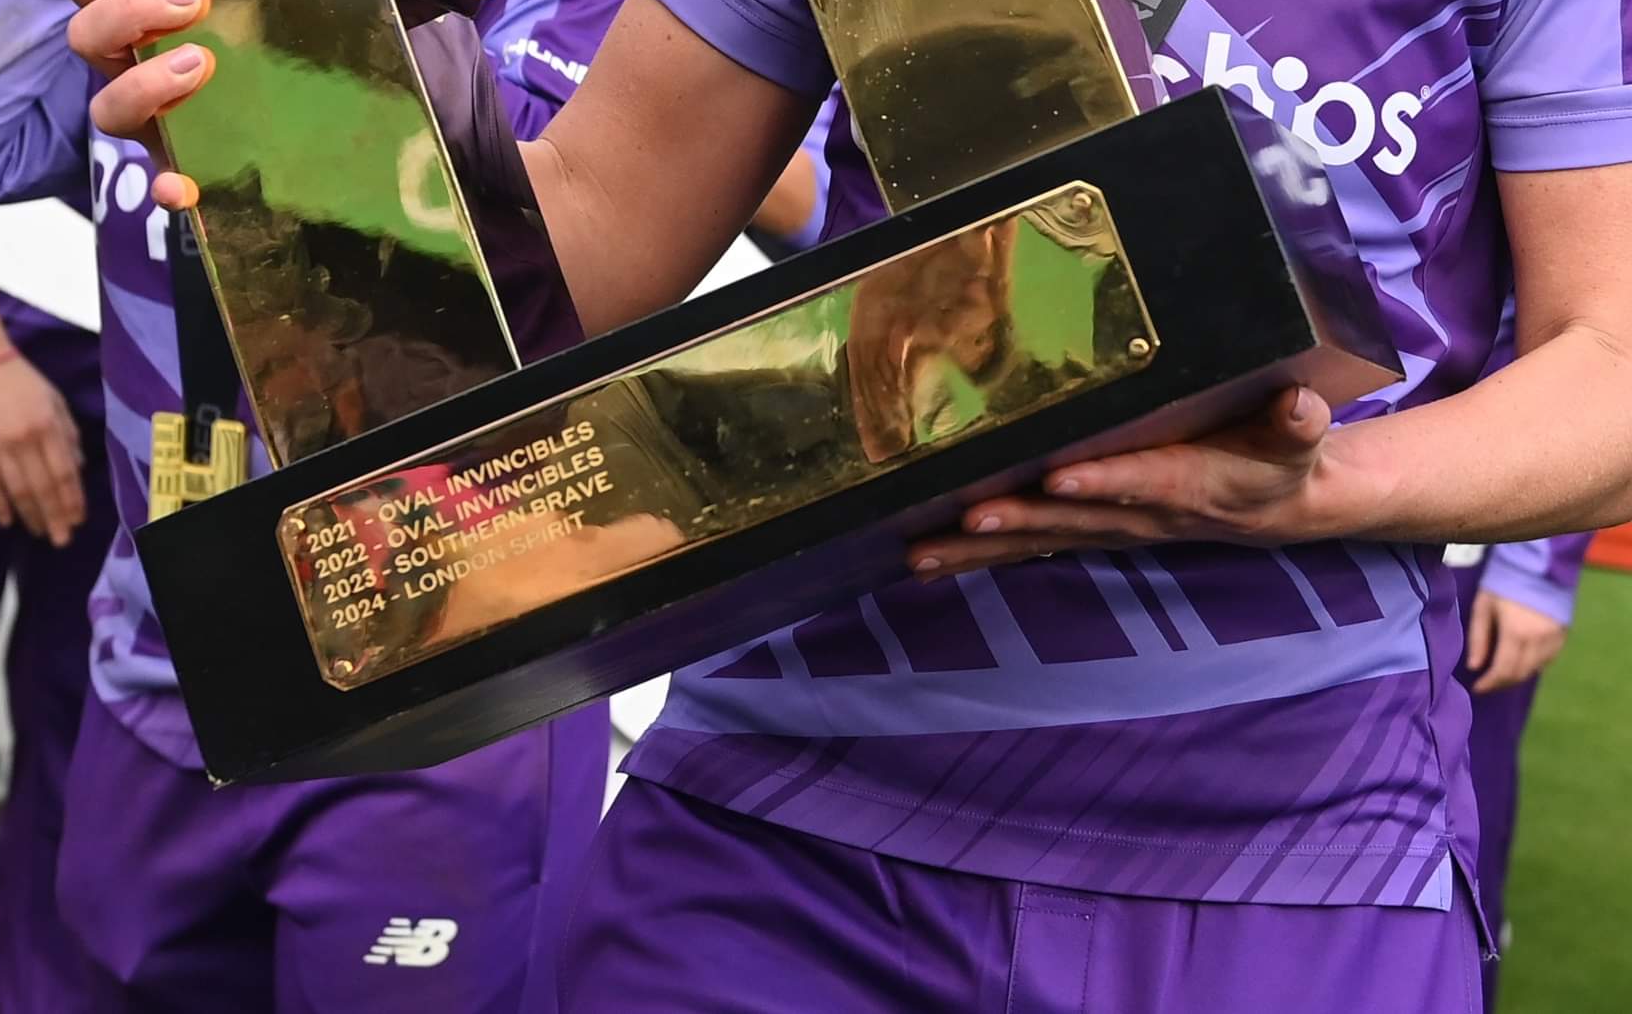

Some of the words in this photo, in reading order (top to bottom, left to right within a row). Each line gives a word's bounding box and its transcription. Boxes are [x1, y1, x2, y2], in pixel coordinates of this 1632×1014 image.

[306, 519, 357, 553] 2021
[378, 485, 445, 523] OVAL
[446, 421, 596, 497] INVINCIBLES
[314, 544, 369, 580] 2022
[387, 511, 454, 549] OVAL
[455, 445, 605, 523] INVINCIBLES
[322, 569, 378, 606] 2023
[394, 504, 532, 575] SOUTHERN
[530, 471, 614, 515] BRAVE
[331, 594, 387, 630] 2024
[404, 547, 509, 601] LONDON
[509, 511, 588, 557] SPIRIT
